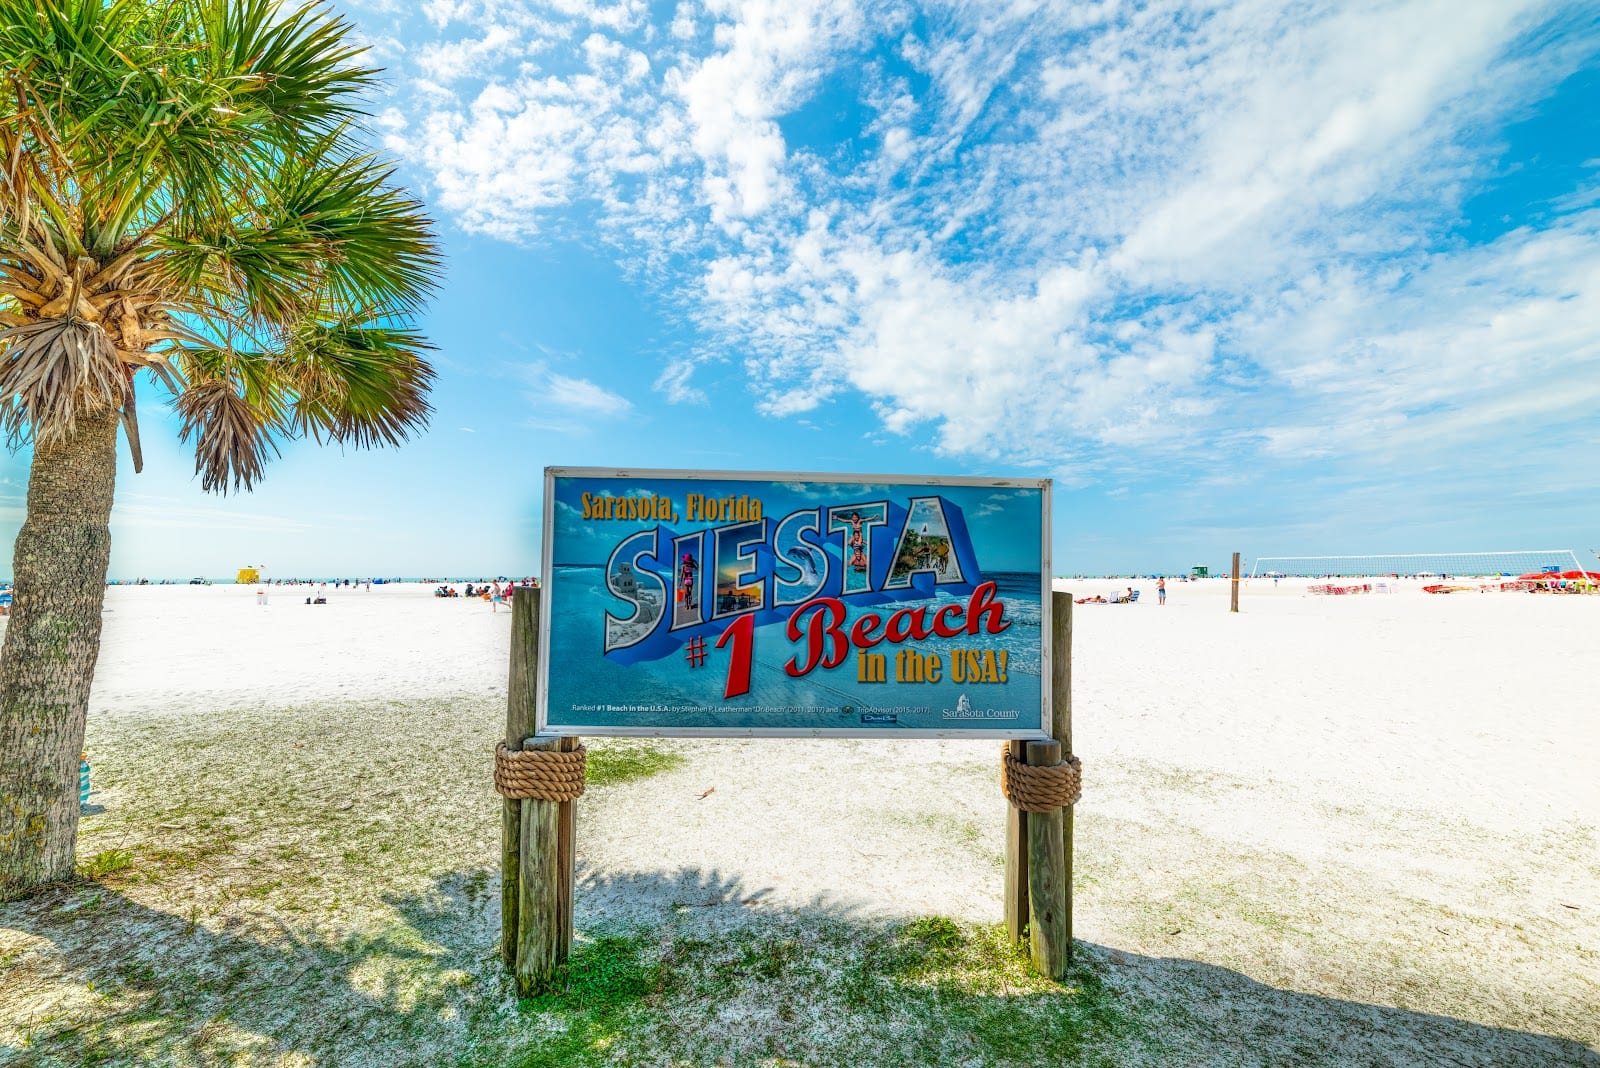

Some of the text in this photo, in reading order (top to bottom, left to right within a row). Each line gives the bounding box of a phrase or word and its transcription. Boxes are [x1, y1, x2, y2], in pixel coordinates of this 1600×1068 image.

[581, 491, 763, 524] Sarasota, Florida
[604, 495, 966, 656] SIESTA
[784, 580, 1012, 678] Beach
[857, 650, 1009, 684] in the USA!
[572, 704, 596, 712] Ranked
[597, 704, 606, 712] #1
[607, 704, 628, 712] Beach
[629, 704, 636, 712] in
[637, 704, 649, 712] the
[672, 705, 681, 714] by
[826, 705, 839, 713] and
[942, 708, 1020, 719] Sarasota County
